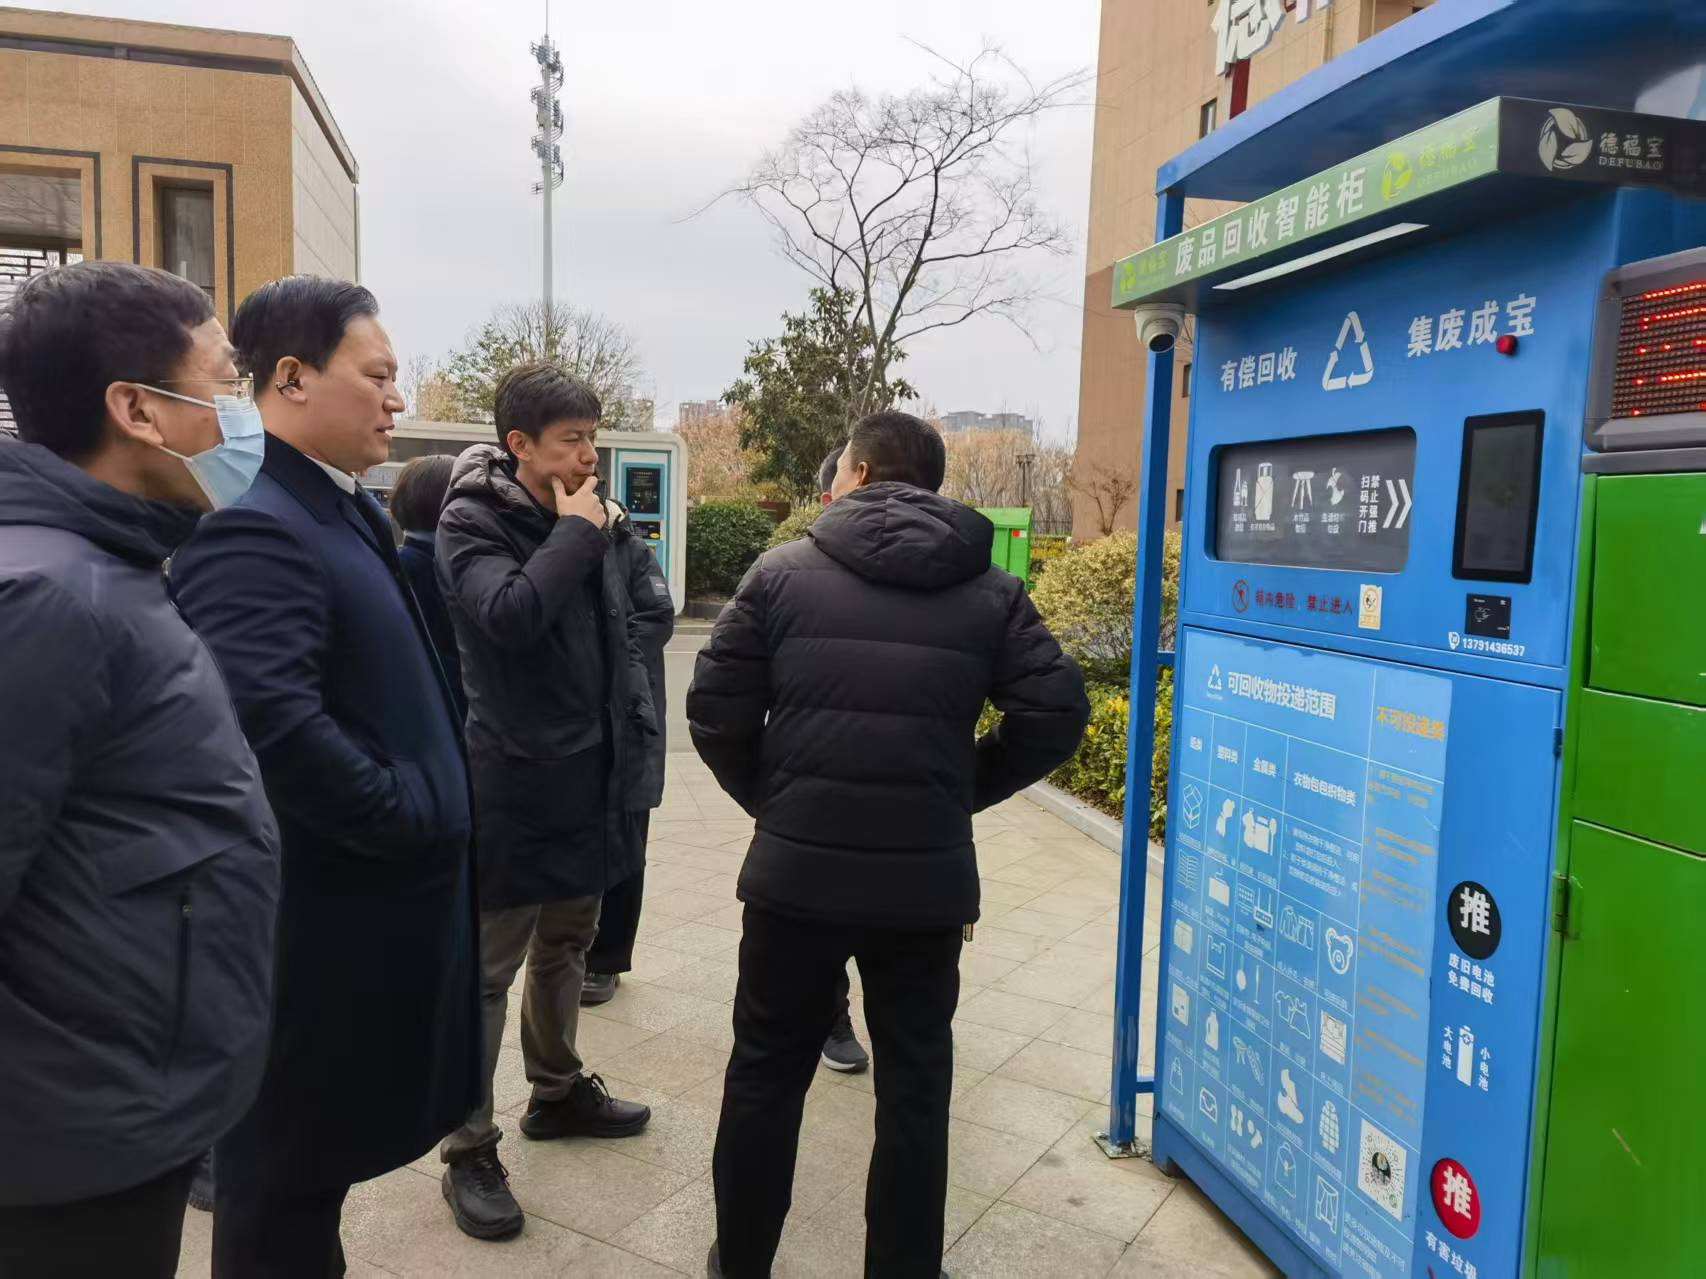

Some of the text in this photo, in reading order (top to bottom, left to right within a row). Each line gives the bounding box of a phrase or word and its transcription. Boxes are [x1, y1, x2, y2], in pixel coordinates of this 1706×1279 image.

[1599, 155, 1664, 171] DEFUBAO
[1600, 132, 1664, 158] 德福宝
[1174, 167, 1367, 277] 废品回收智能柜
[1407, 293, 1537, 358] 集废成宝
[1220, 346, 1298, 392] 有偿回收
[1462, 637, 1526, 657] 13791436537
[1228, 671, 1336, 721] 可回收物投递范围
[1459, 886, 1492, 936] 推
[1447, 970, 1494, 1005] 免费回收
[1448, 952, 1495, 988] 废旧电池
[1442, 1025, 1454, 1070] 大电池
[1478, 1047, 1492, 1092] 小电池
[1442, 1166, 1472, 1220] 推
